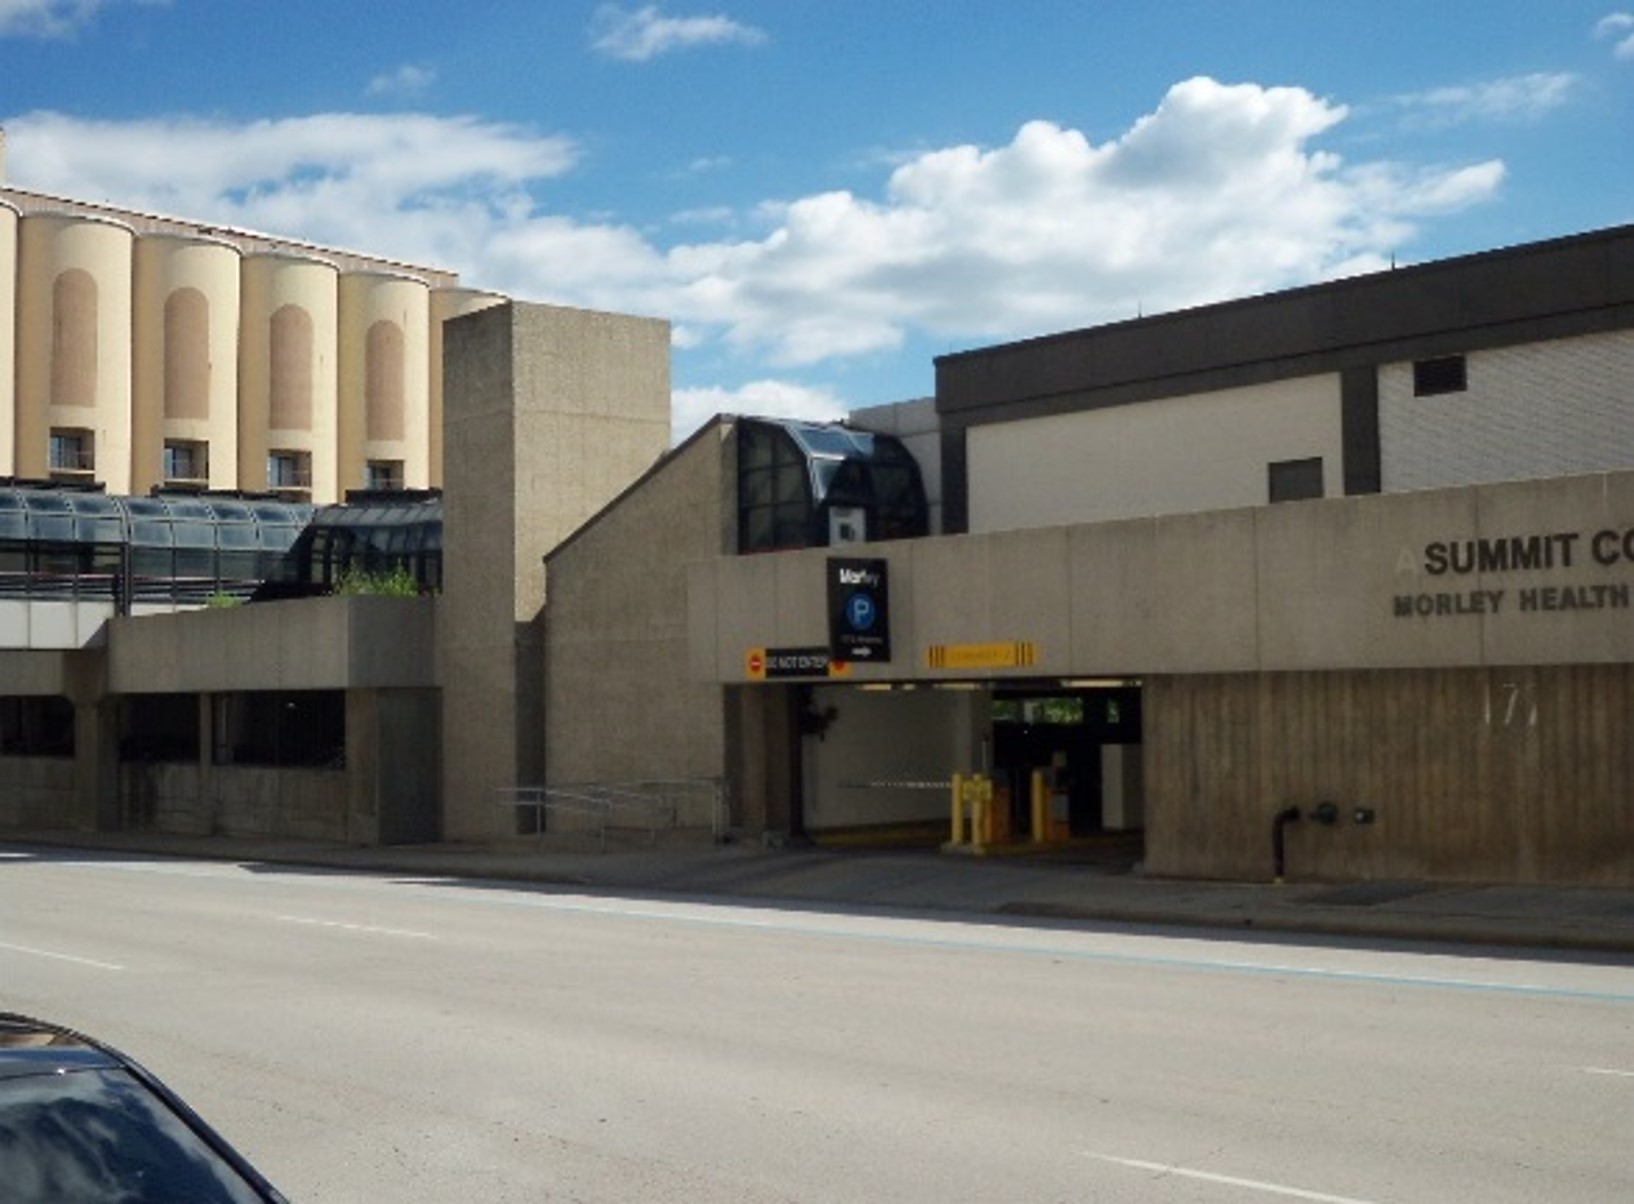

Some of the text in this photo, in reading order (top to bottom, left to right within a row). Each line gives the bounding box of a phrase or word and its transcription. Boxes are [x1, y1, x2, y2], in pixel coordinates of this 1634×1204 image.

[1424, 533, 1579, 575] SUMMIT
[854, 599, 870, 622] P
[1393, 583, 1630, 617] MORLEY HEALTH
[779, 655, 797, 669] NOT
